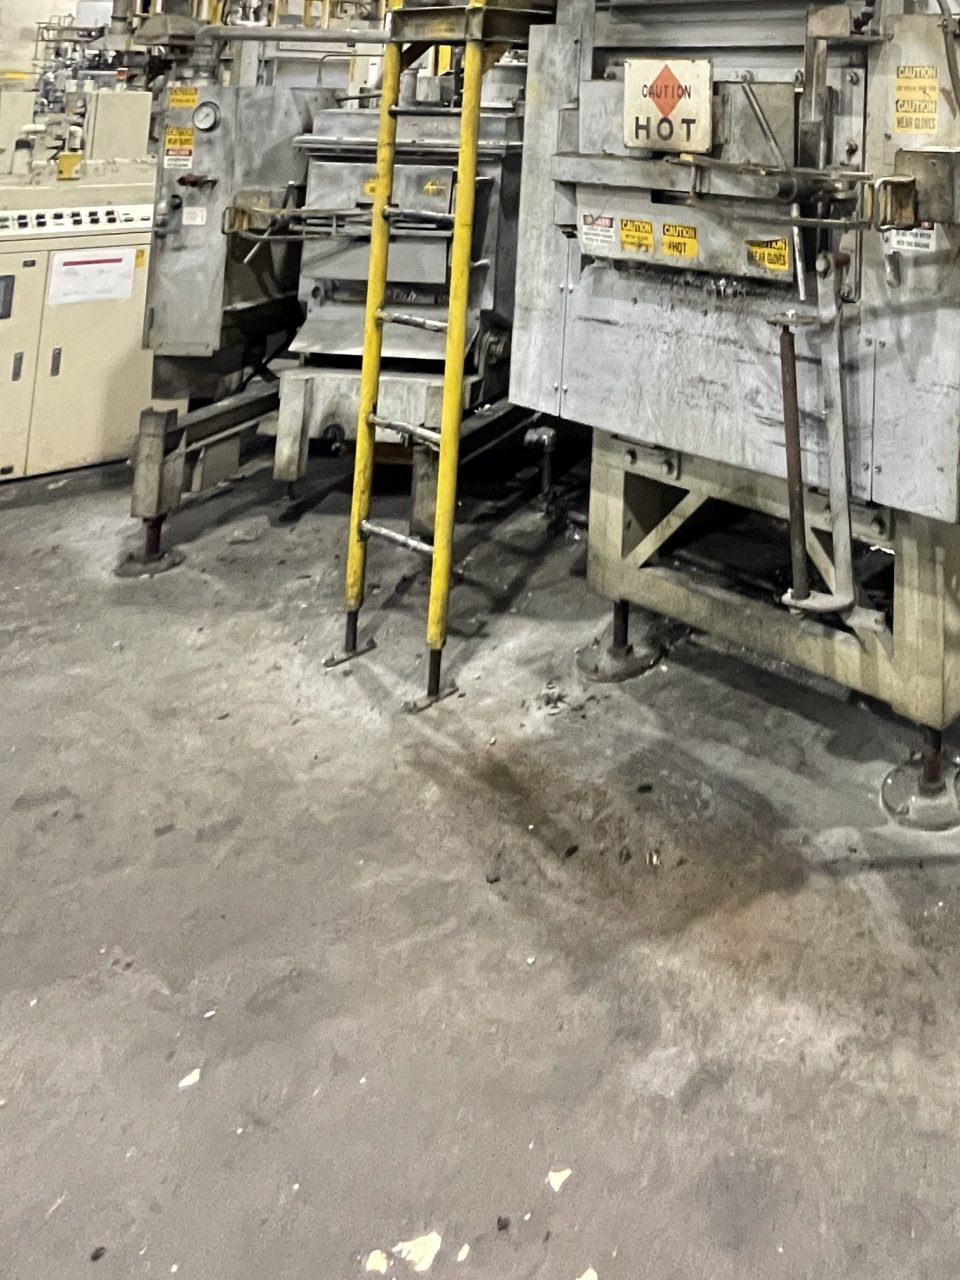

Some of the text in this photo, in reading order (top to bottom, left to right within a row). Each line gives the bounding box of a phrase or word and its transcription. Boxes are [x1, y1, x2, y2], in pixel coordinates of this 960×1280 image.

[898, 66, 937, 78] CAUTION
[641, 84, 691, 99] CAUTION
[897, 100, 937, 112] CAUTION
[634, 116, 696, 142] HOT
[897, 117, 913, 128] WEAR
[621, 219, 652, 233] CAUTION
[663, 224, 696, 239] CAUTION
[671, 241, 687, 253] HOT
